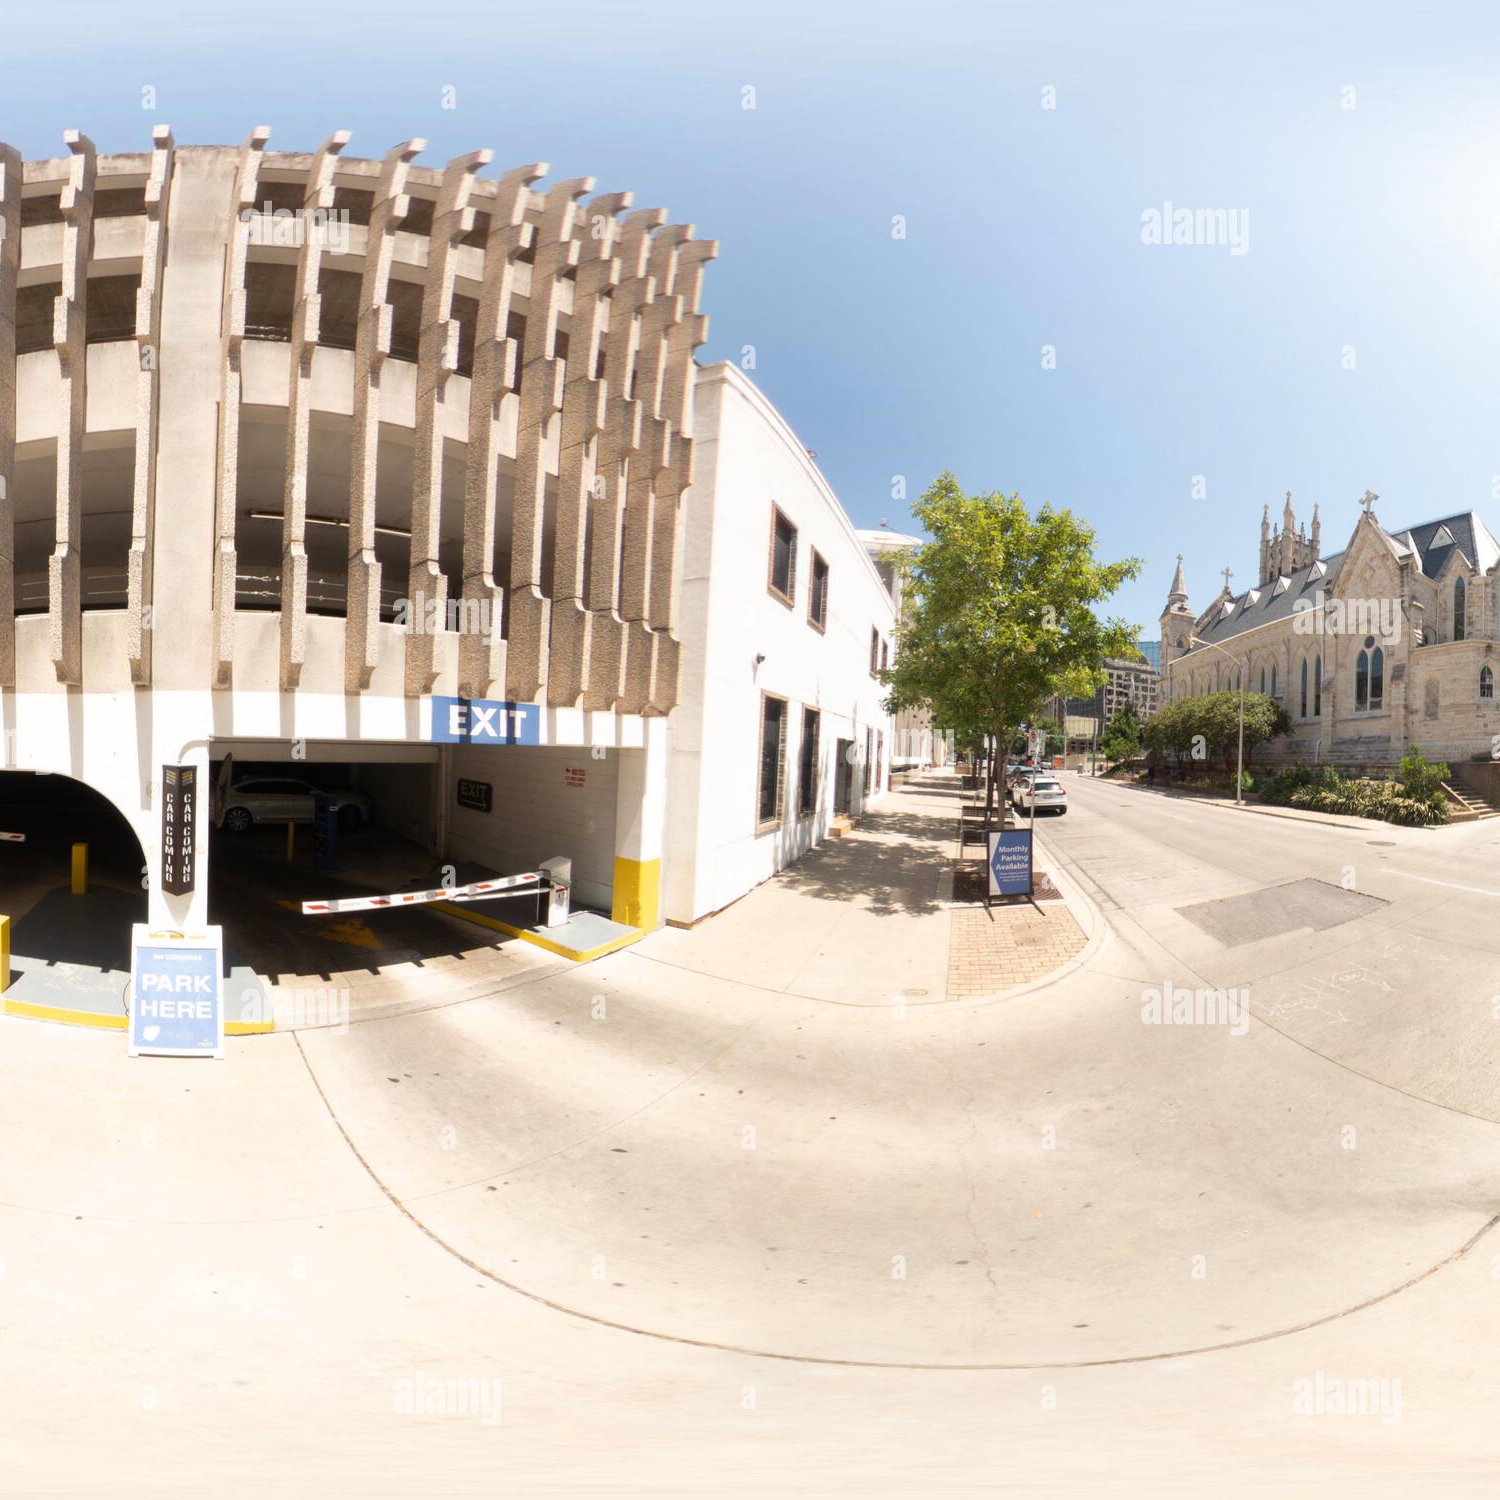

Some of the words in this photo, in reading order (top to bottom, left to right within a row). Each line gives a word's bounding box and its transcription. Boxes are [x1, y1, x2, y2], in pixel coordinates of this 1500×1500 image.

[449, 704, 527, 738] EXIT
[460, 782, 488, 797] EXIT
[166, 793, 174, 822] CAR
[165, 826, 174, 883] COMING
[182, 827, 192, 883] COMING
[999, 845, 1029, 853] Monthly
[1001, 854, 1029, 862] Parking
[996, 862, 1029, 871] Available
[141, 973, 212, 992] PARK
[140, 1000, 213, 1018] HERE
